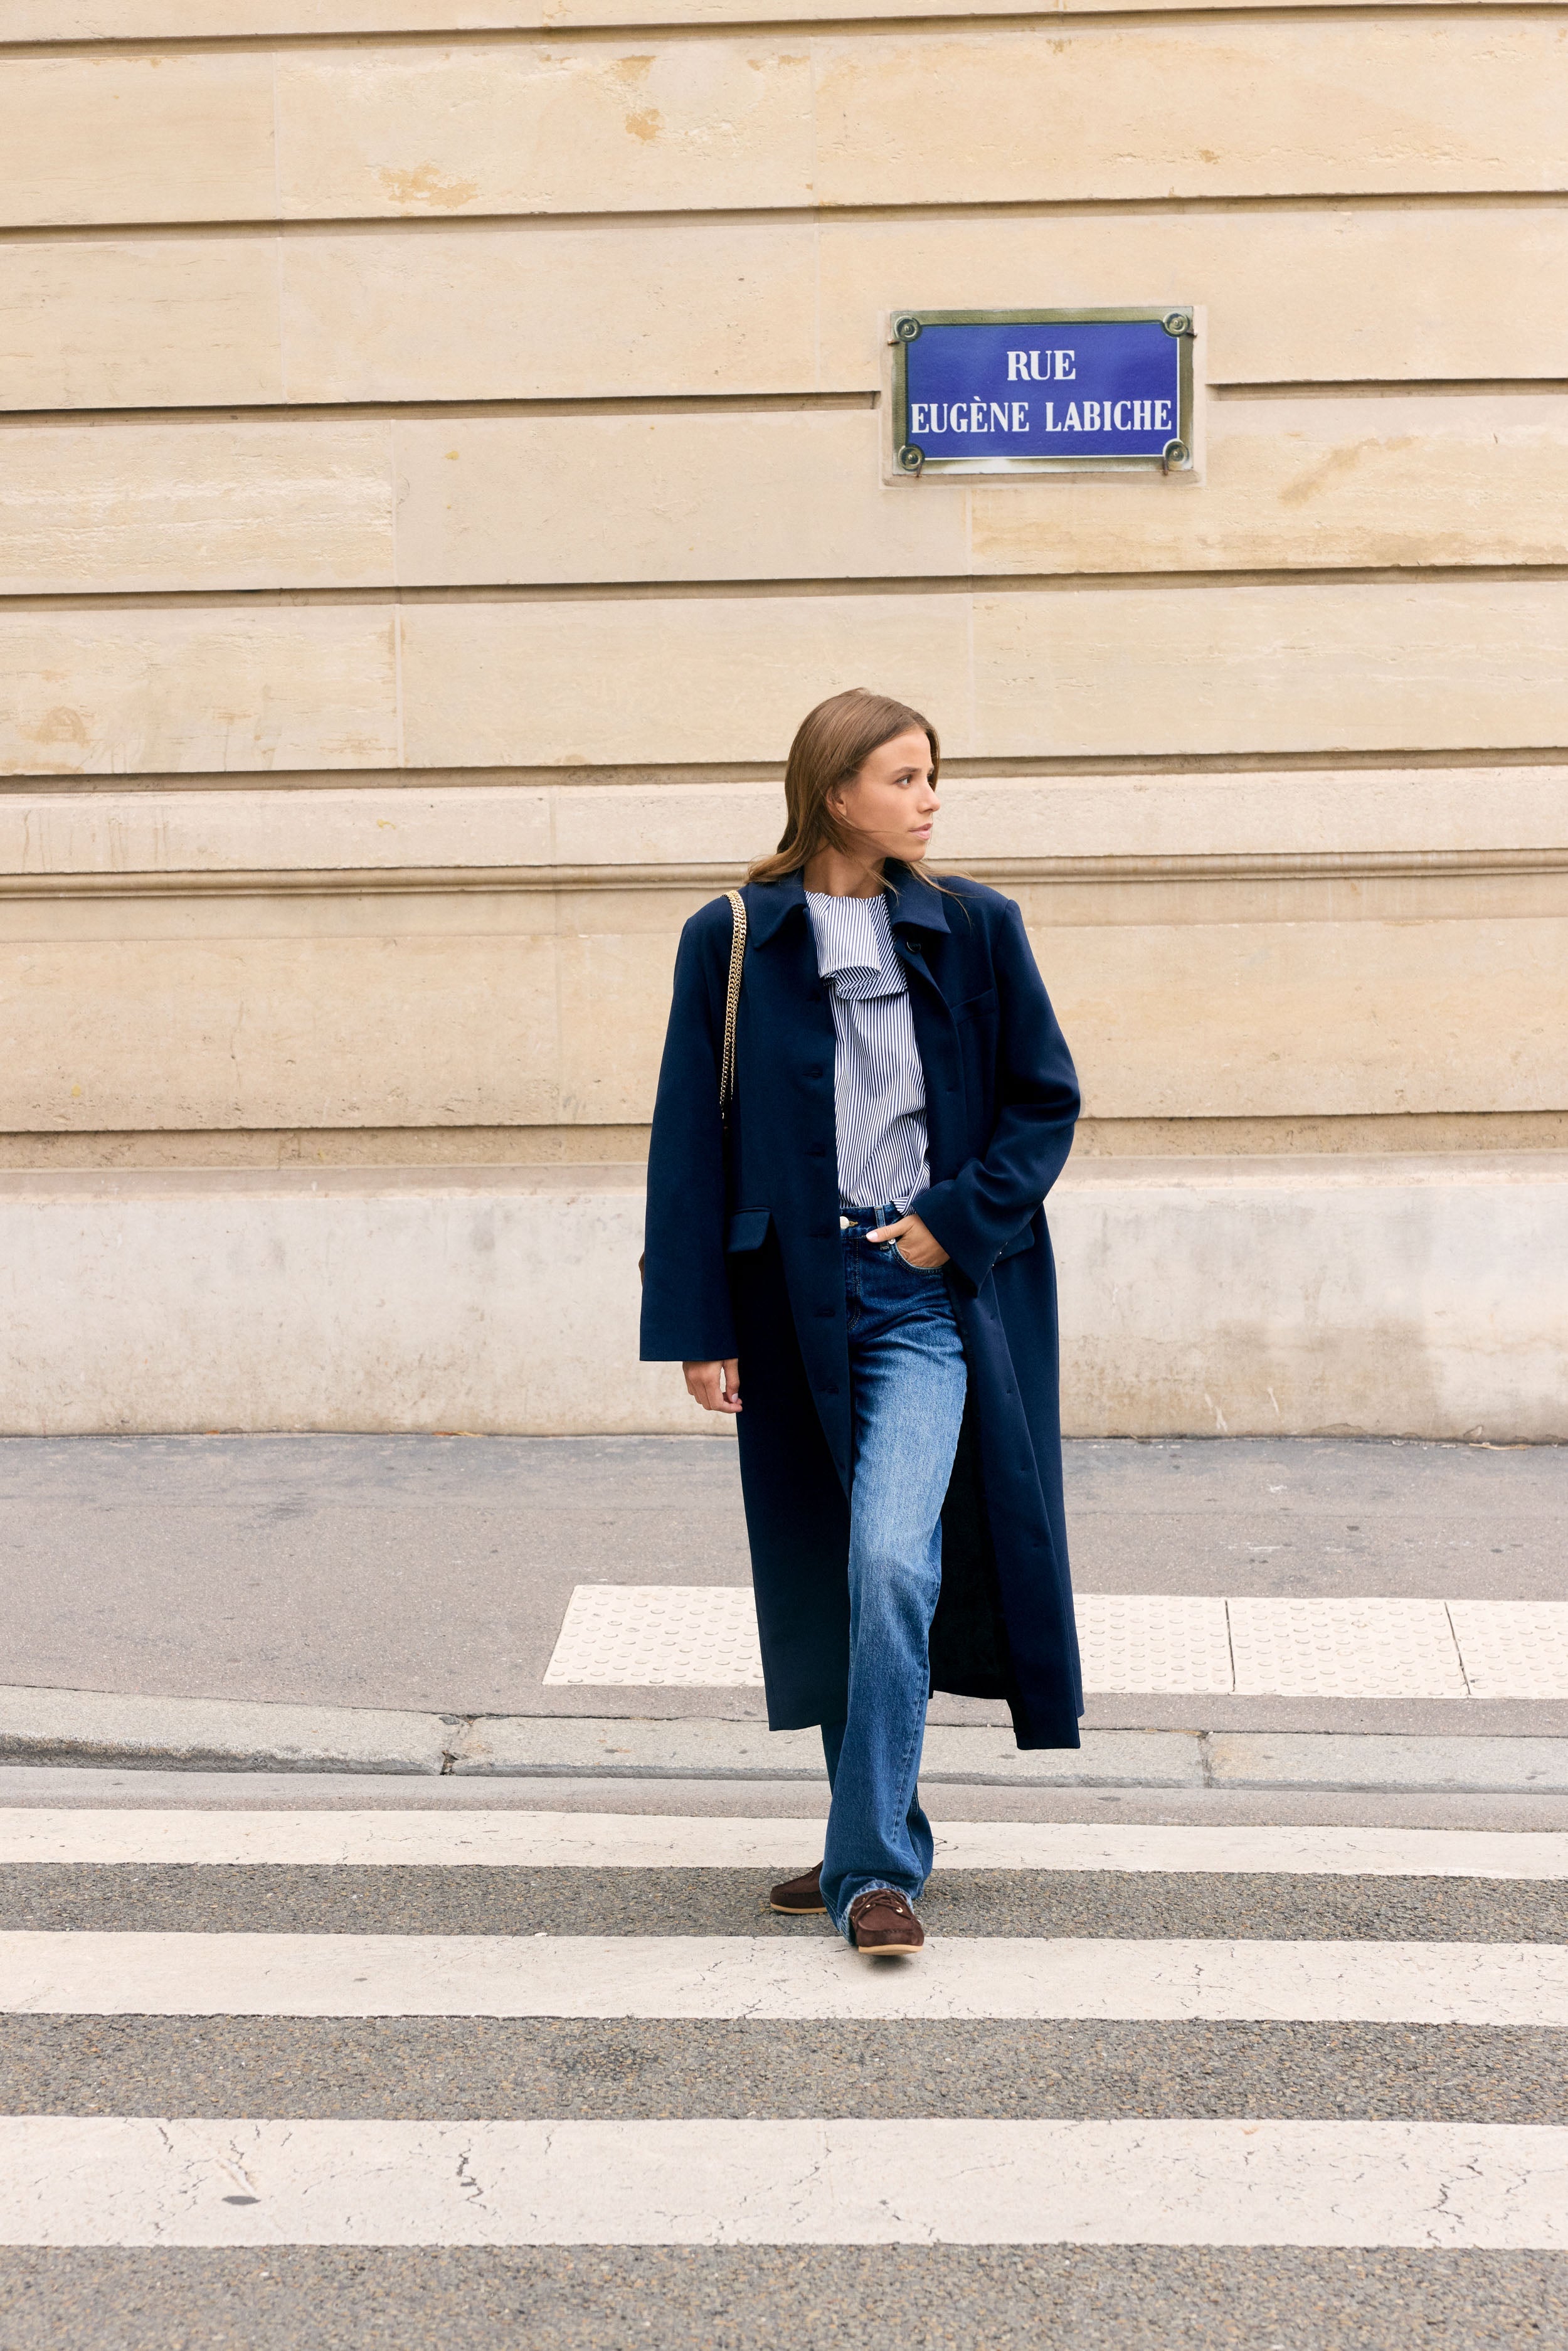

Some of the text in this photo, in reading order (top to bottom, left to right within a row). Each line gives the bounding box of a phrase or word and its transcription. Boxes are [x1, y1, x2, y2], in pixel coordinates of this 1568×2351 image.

[1007, 349, 1076, 381] RUE
[911, 396, 1172, 433] EUGÈNE LABICHE
